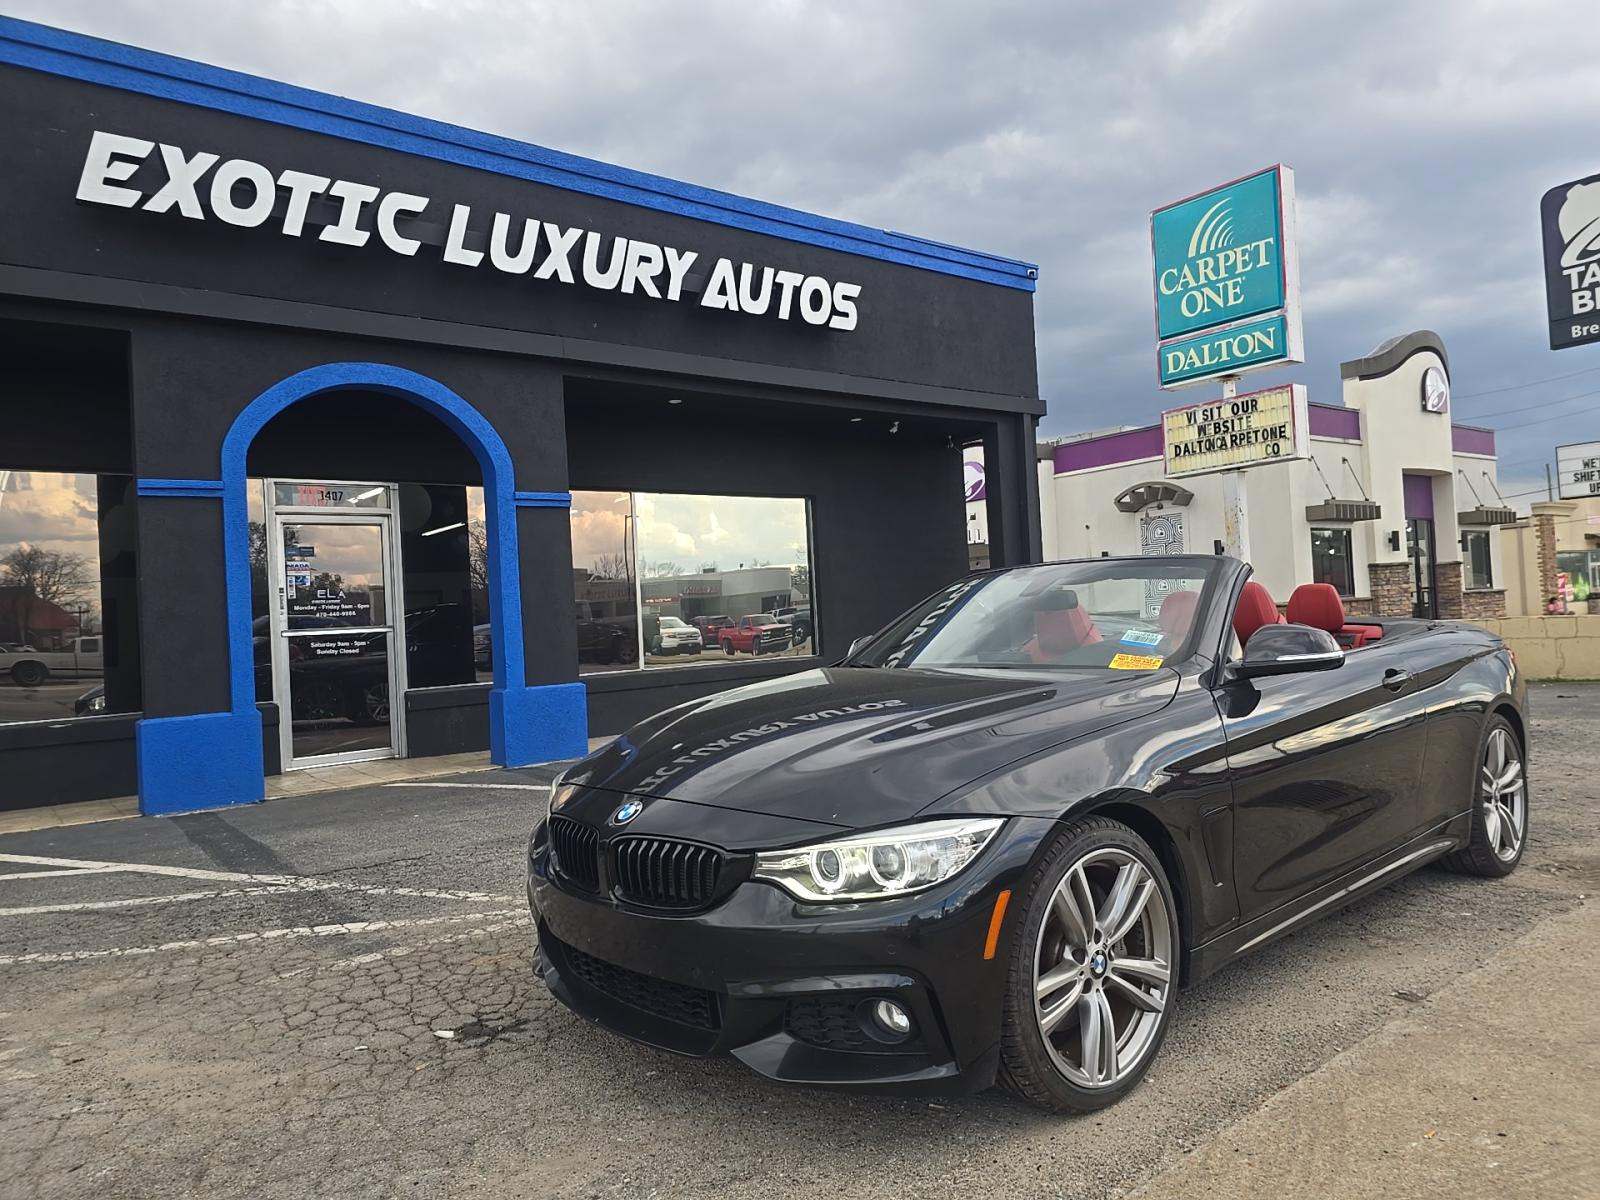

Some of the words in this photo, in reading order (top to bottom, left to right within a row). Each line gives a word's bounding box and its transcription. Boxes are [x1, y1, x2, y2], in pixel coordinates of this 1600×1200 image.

[76, 131, 429, 256] EXOTIC
[443, 204, 698, 301] LUXURY
[700, 257, 862, 331] AUTOS
[1159, 237, 1274, 295] CARPET
[1181, 278, 1245, 318] ONE
[1572, 287, 1600, 315] B
[1166, 327, 1276, 374] DALTON
[1231, 399, 1258, 415] OUR
[1197, 415, 1252, 437] WEBSITE
[317, 588, 346, 599] ELA
